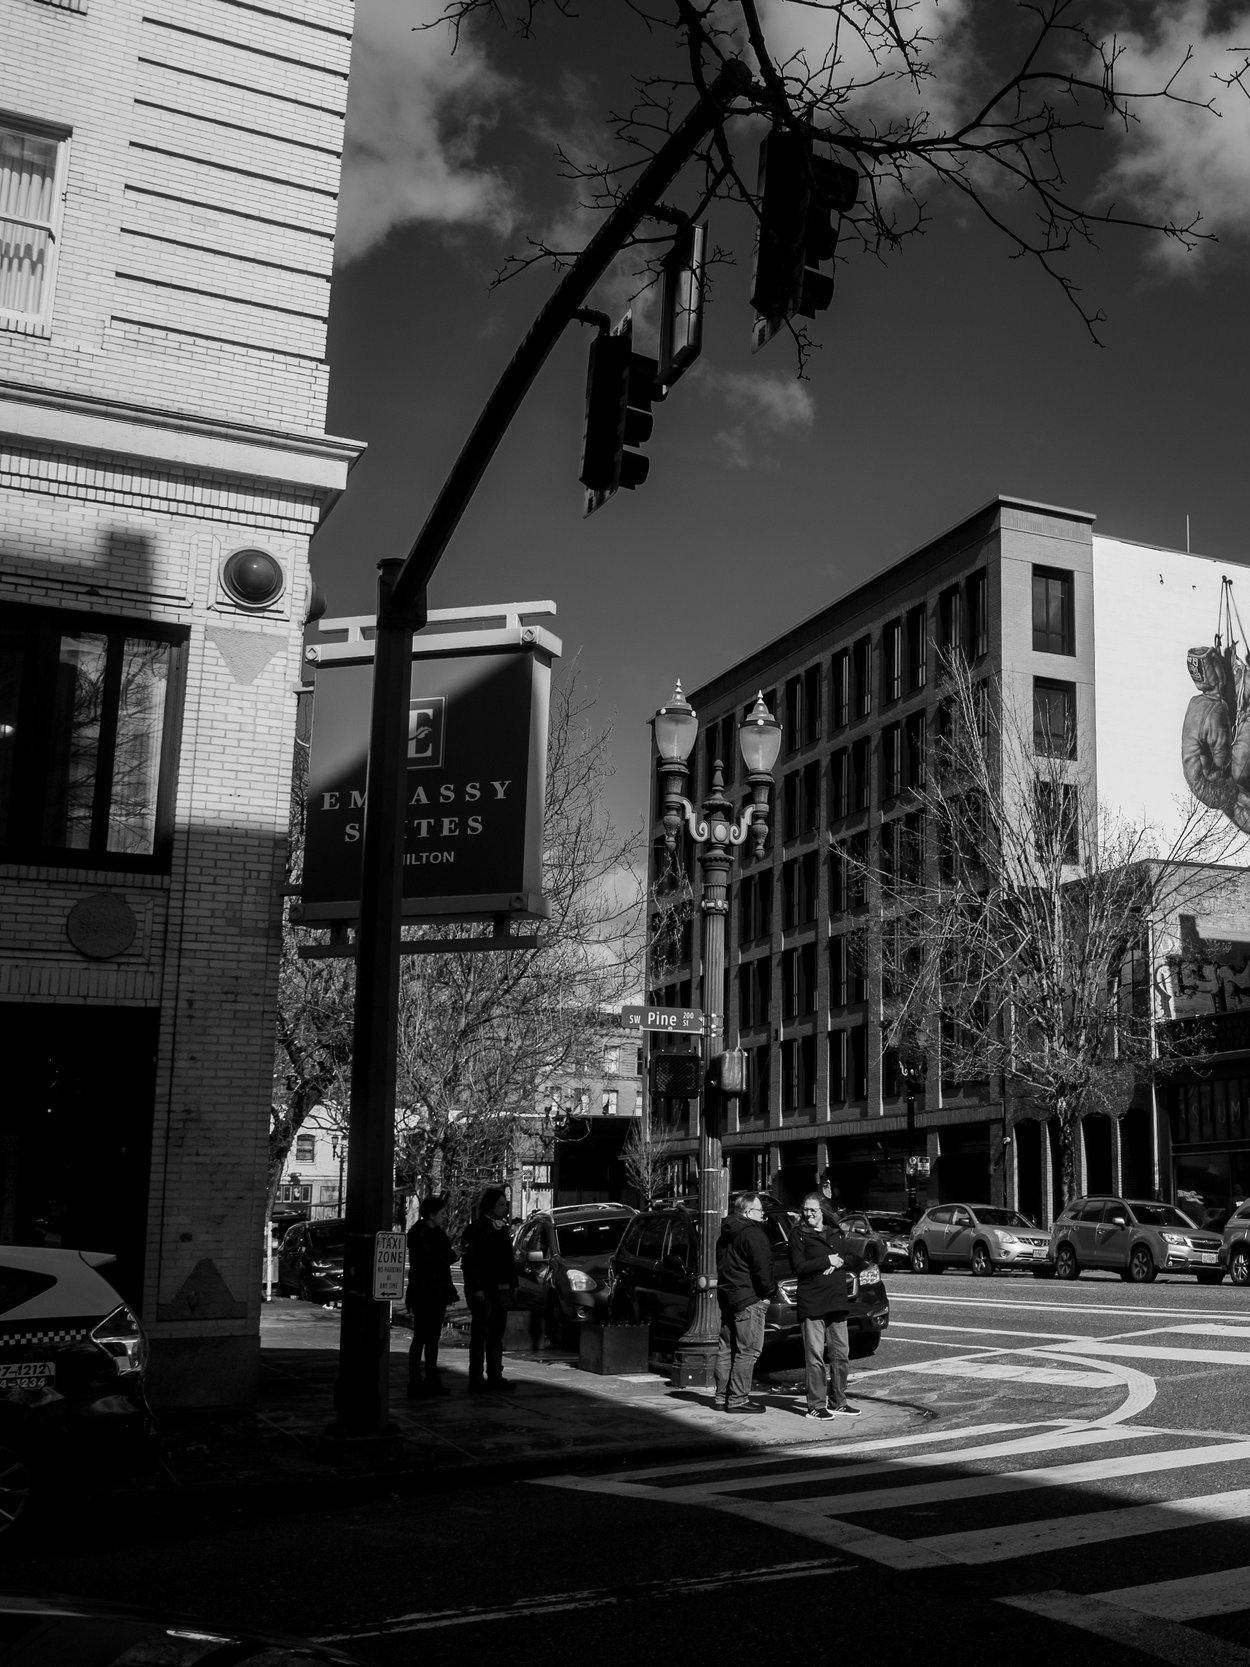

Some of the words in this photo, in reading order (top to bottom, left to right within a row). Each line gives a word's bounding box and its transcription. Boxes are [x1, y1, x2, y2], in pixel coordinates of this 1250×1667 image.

[320, 780, 512, 810] EMASSY
[344, 815, 483, 842] STES
[402, 851, 455, 866] ILTON
[629, 1014, 641, 1024] SW
[648, 1012, 677, 1026] Pine
[382, 1237, 401, 1249] TAXI
[378, 1251, 403, 1263] ZONE
[0, 1365, 46, 1377] 7-1212
